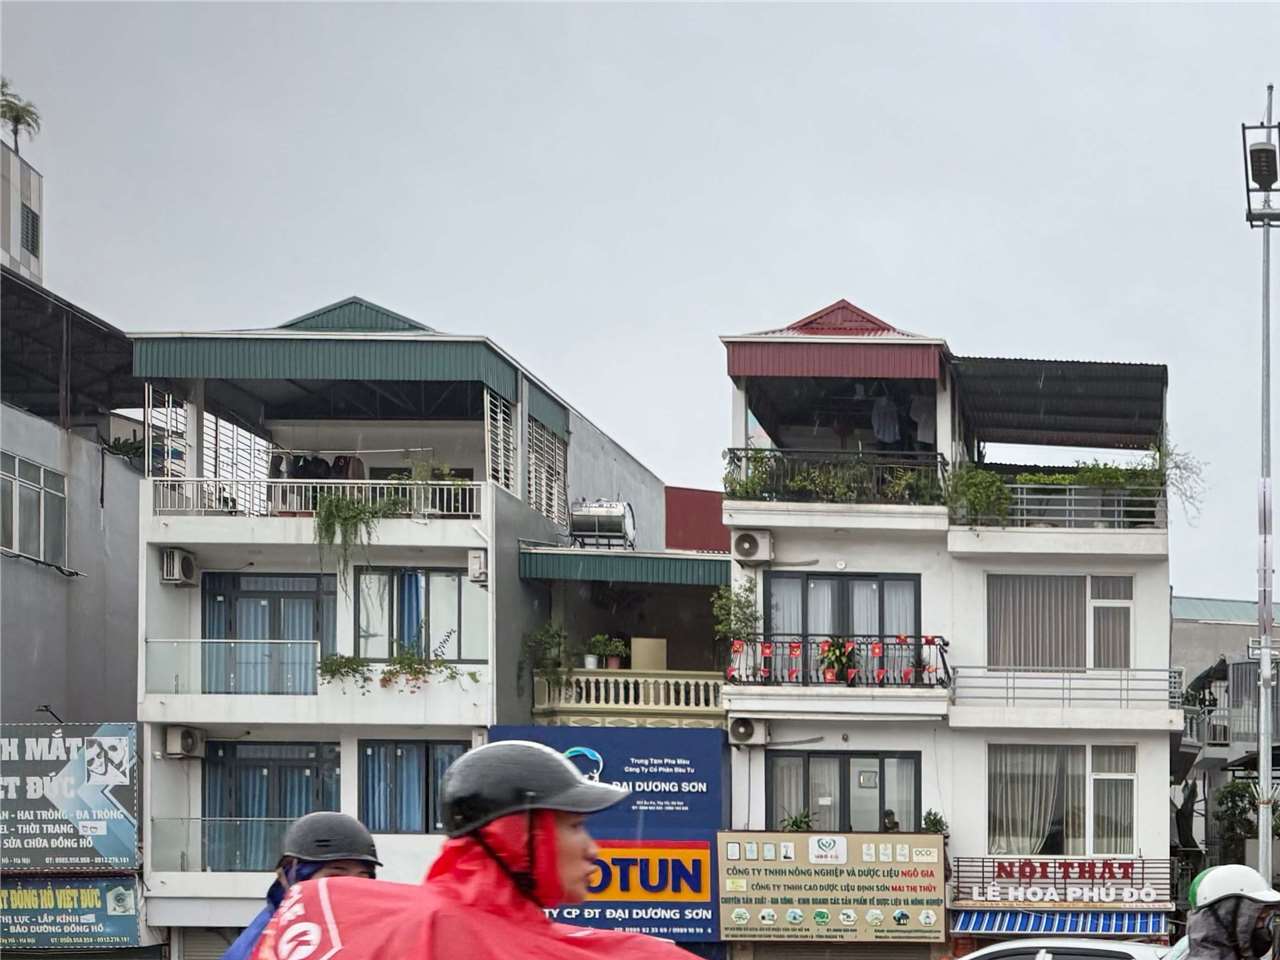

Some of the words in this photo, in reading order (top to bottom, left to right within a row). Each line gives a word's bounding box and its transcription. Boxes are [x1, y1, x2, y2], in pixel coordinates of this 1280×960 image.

[635, 780, 679, 792] DƯƠNG
[681, 780, 707, 792] SƠN
[17, 810, 34, 820] HAI
[17, 821, 39, 834] THỜI
[42, 823, 74, 834] TRANG
[726, 865, 750, 877] CÔNG
[751, 867, 762, 877] TY
[764, 867, 787, 877] TNHH
[788, 866, 813, 877] NÔNG
[901, 867, 919, 878] NGÔ
[920, 869, 935, 878] GIA
[972, 881, 1001, 901] LÊ
[1008, 886, 1060, 902] HOA
[1067, 883, 1116, 902] PHÚ
[1122, 882, 1157, 903] ĐÔ
[544, 908, 559, 918] TY
[563, 908, 579, 918] CP
[584, 908, 601, 918] ĐT
[606, 908, 629, 921] ĐẠI
[633, 907, 680, 919] DƯƠNG
[684, 906, 712, 919] SƠN
